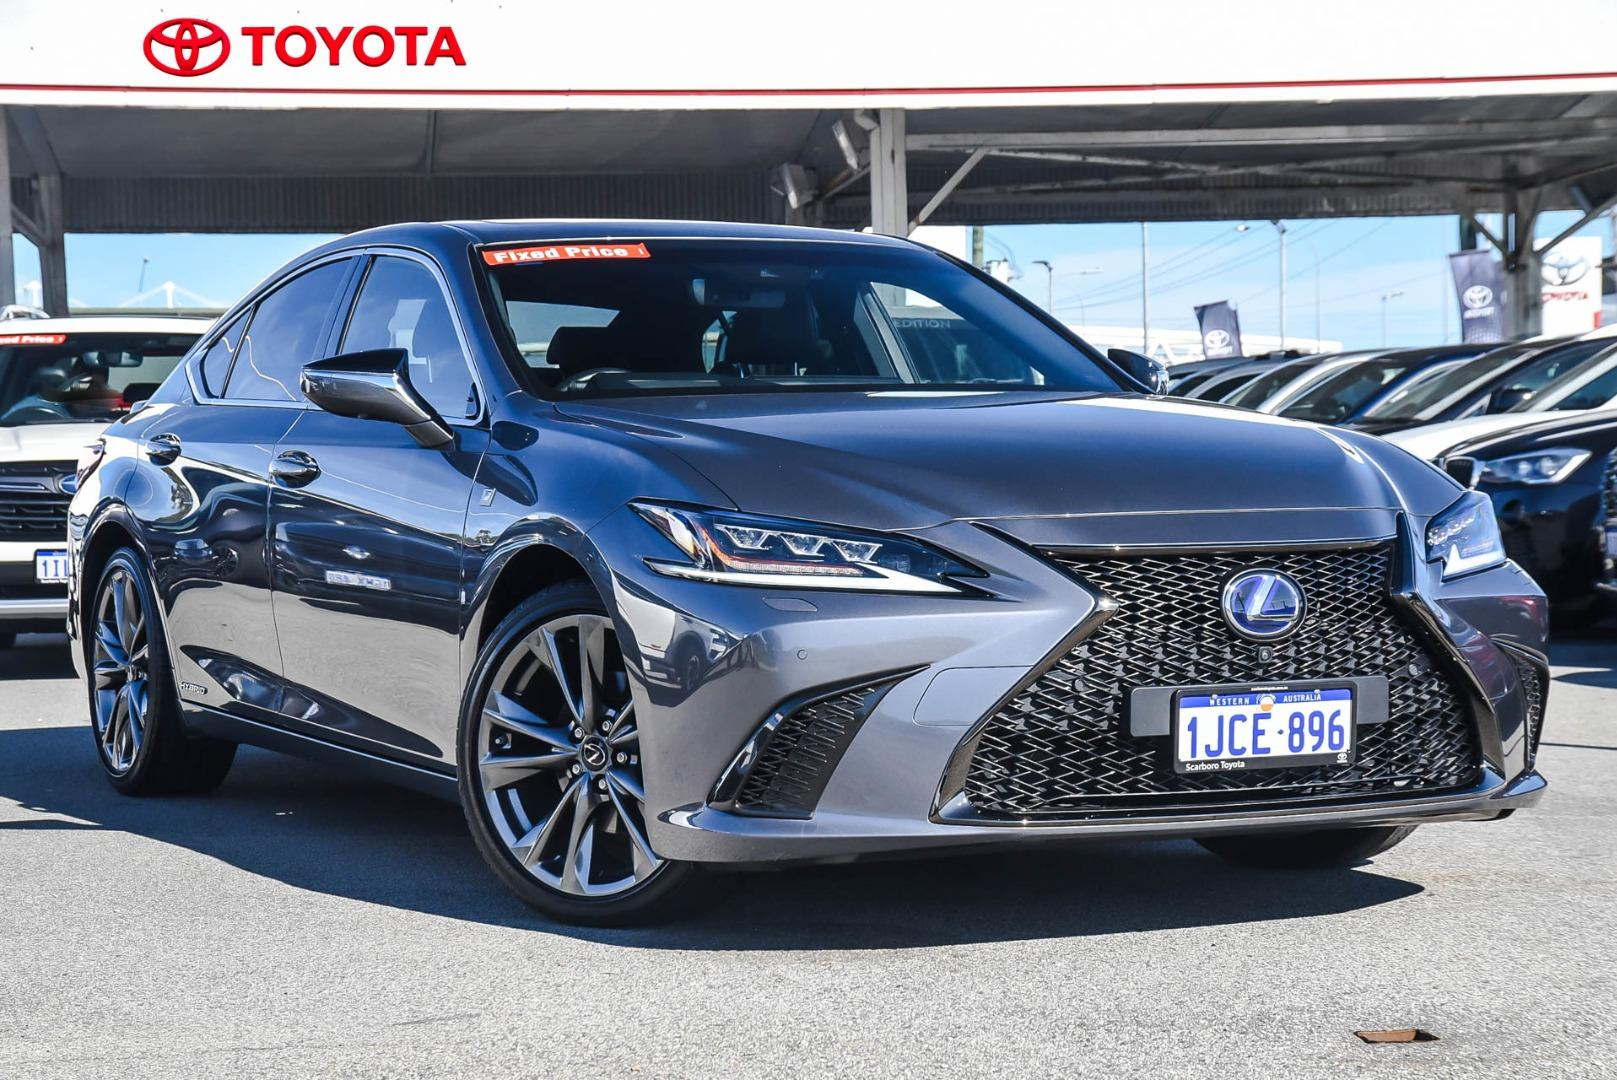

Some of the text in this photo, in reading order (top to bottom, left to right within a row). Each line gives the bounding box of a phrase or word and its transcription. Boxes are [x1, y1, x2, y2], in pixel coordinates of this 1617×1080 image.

[241, 25, 467, 67] TOYOTA
[494, 246, 629, 263] Fixed Price
[1209, 692, 1321, 706] WESTERN AUSTRALIA
[1185, 760, 1246, 771] Scarboro Toyota
